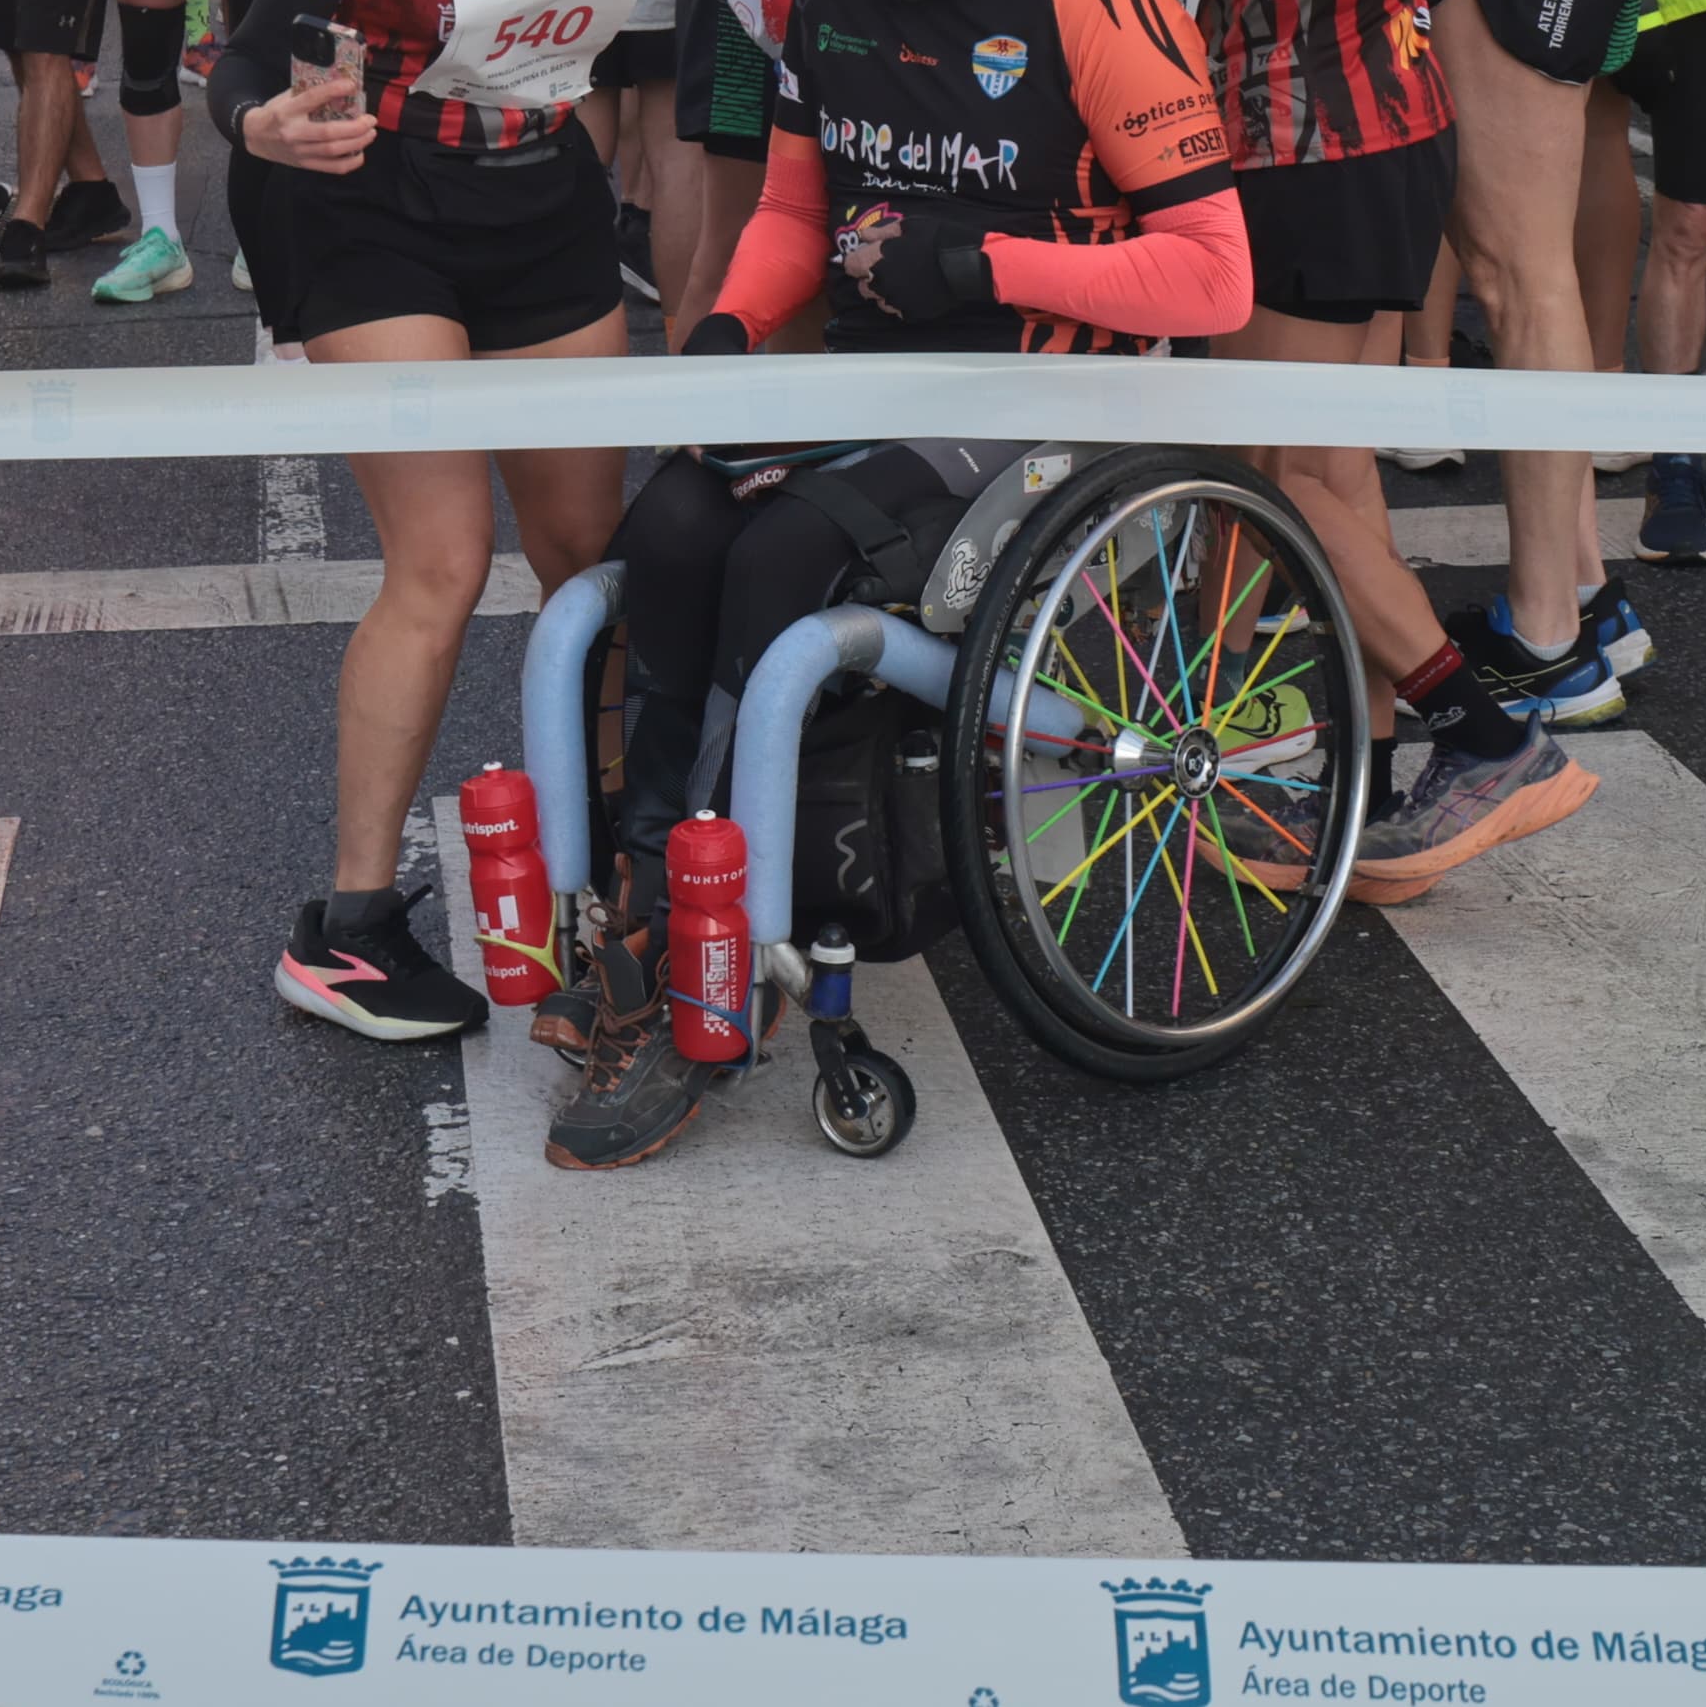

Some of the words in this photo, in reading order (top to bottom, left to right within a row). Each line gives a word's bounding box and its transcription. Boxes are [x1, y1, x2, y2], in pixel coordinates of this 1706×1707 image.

[485, 5, 594, 62] 540
[1123, 96, 1196, 131] ópticas
[941, 131, 1020, 191] MAR
[398, 1594, 683, 1633] Ayuntamiento
[698, 1607, 748, 1634] de
[759, 1604, 908, 1644] Málaga
[1238, 1619, 1518, 1661] Ayuntamiento
[1530, 1631, 1580, 1661] de
[396, 1636, 468, 1666] Área
[478, 1644, 516, 1668] de
[527, 1645, 646, 1675] Deporte
[1240, 1666, 1314, 1696] Área
[1321, 1674, 1359, 1698] de
[1367, 1677, 1486, 1705] Deporte
